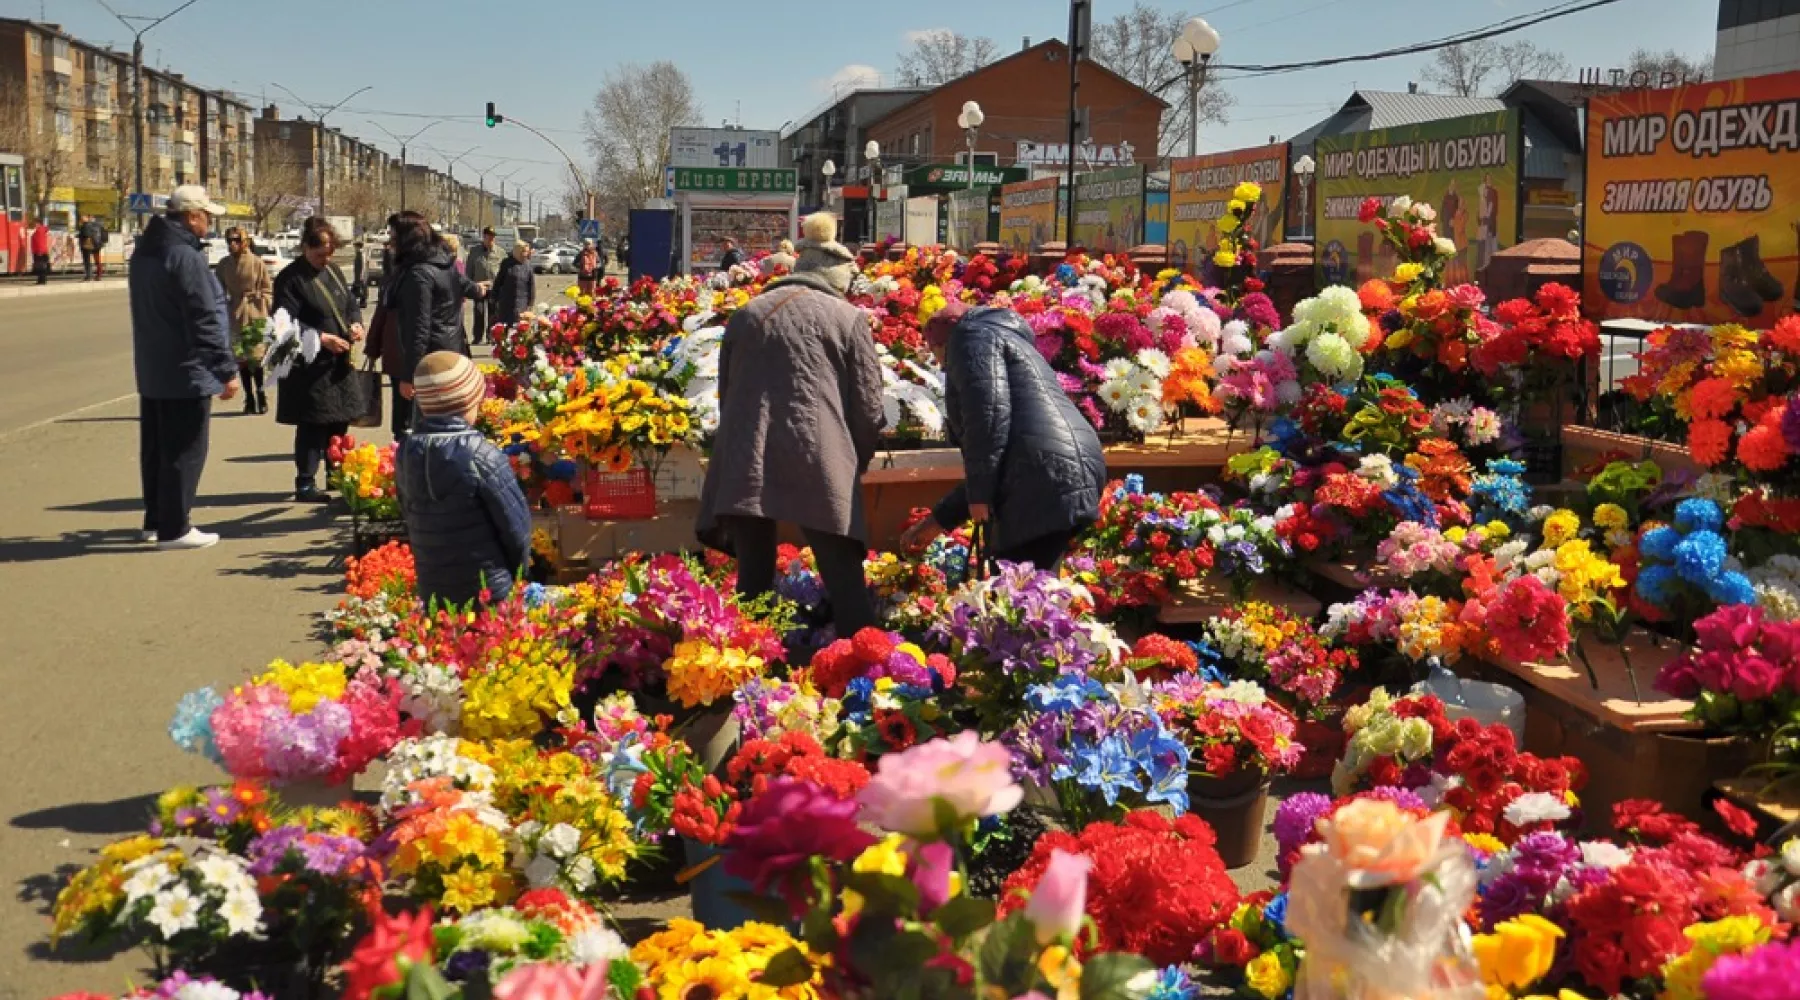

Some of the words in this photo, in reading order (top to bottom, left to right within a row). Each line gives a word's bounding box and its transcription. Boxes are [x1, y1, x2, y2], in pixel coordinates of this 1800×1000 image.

[1603, 115, 1666, 156] МИР
[1672, 102, 1798, 155] ОДЕЖД
[1324, 152, 1354, 178] МИР
[1356, 144, 1425, 178] ОДЕЖДЫ
[1428, 142, 1440, 171] И
[1444, 133, 1506, 170] ОБУВИ
[1602, 180, 1690, 212] ЗИМНЯЯ
[1692, 176, 1773, 211] ОБУВЬ
